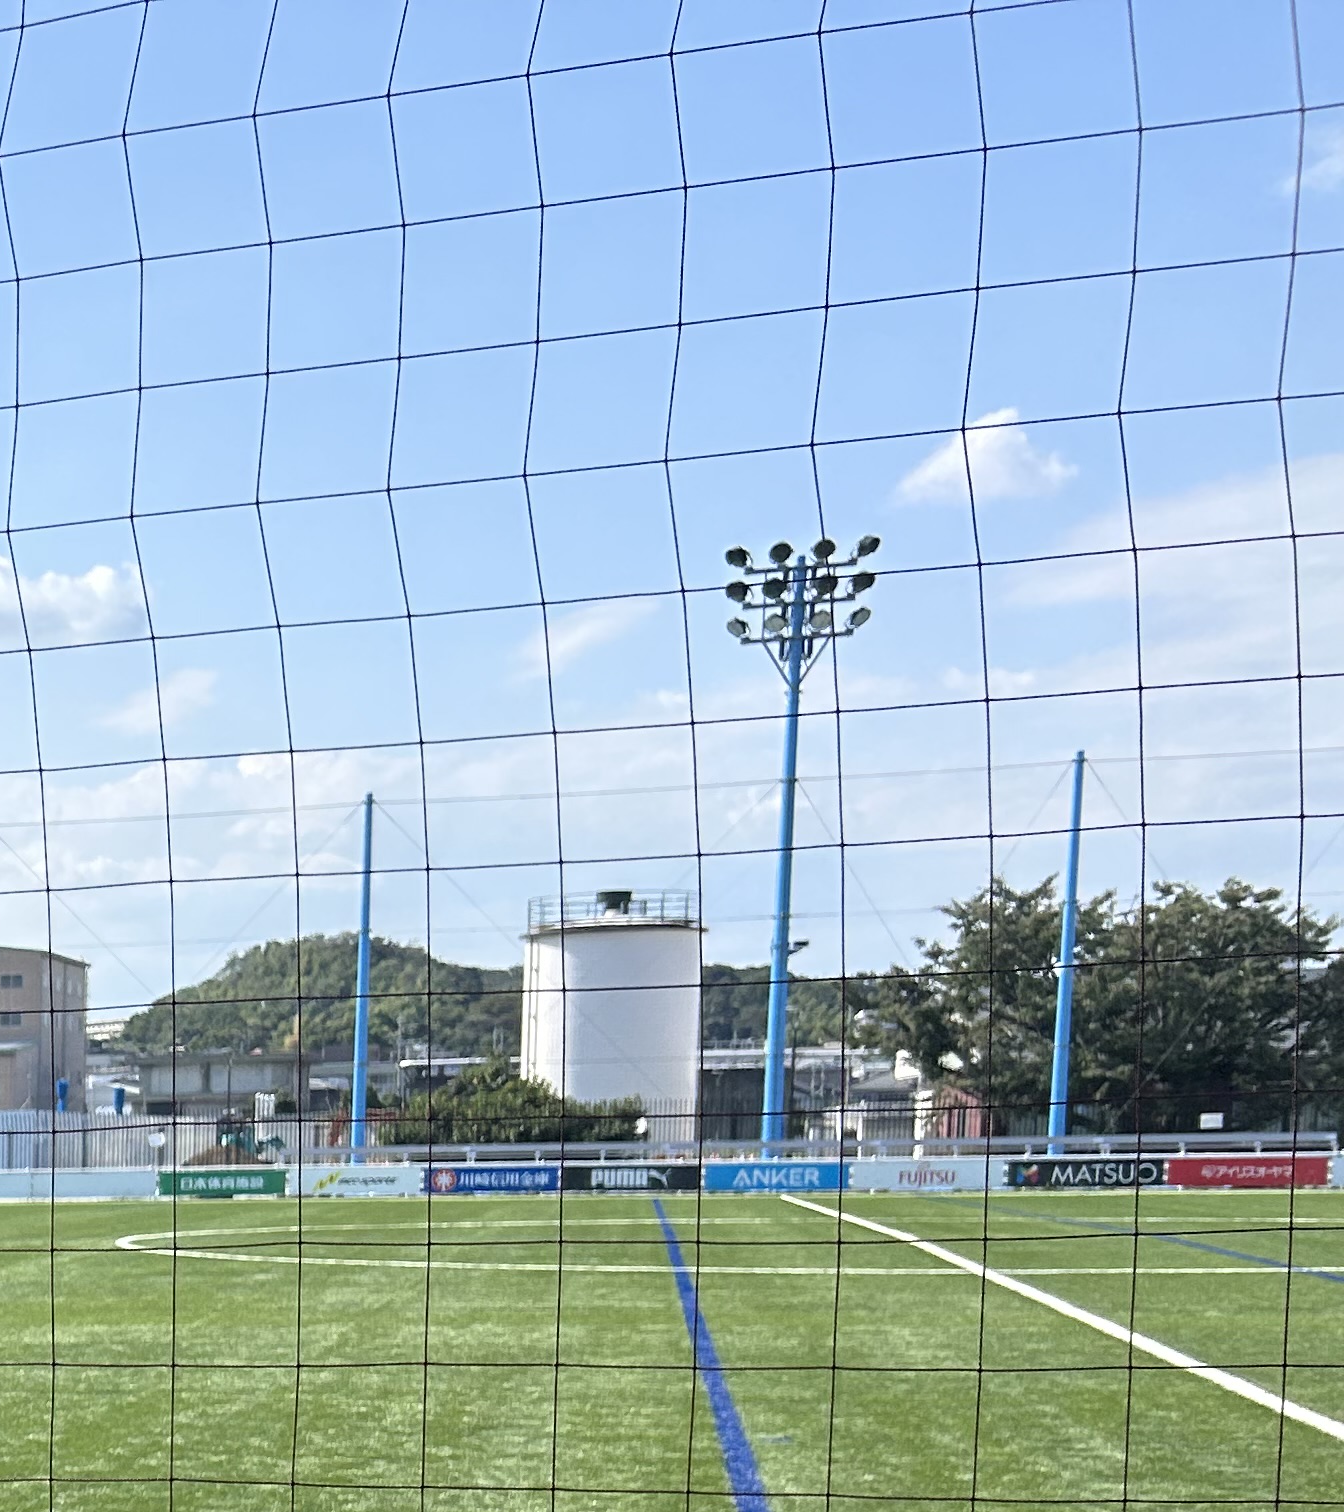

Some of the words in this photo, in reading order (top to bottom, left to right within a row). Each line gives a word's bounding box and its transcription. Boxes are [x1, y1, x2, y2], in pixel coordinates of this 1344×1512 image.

[590, 1168, 649, 1188] PUMA
[732, 1168, 821, 1187] ANKER
[898, 1168, 956, 1186] FUJITSU
[1050, 1163, 1158, 1185] MATSUO
